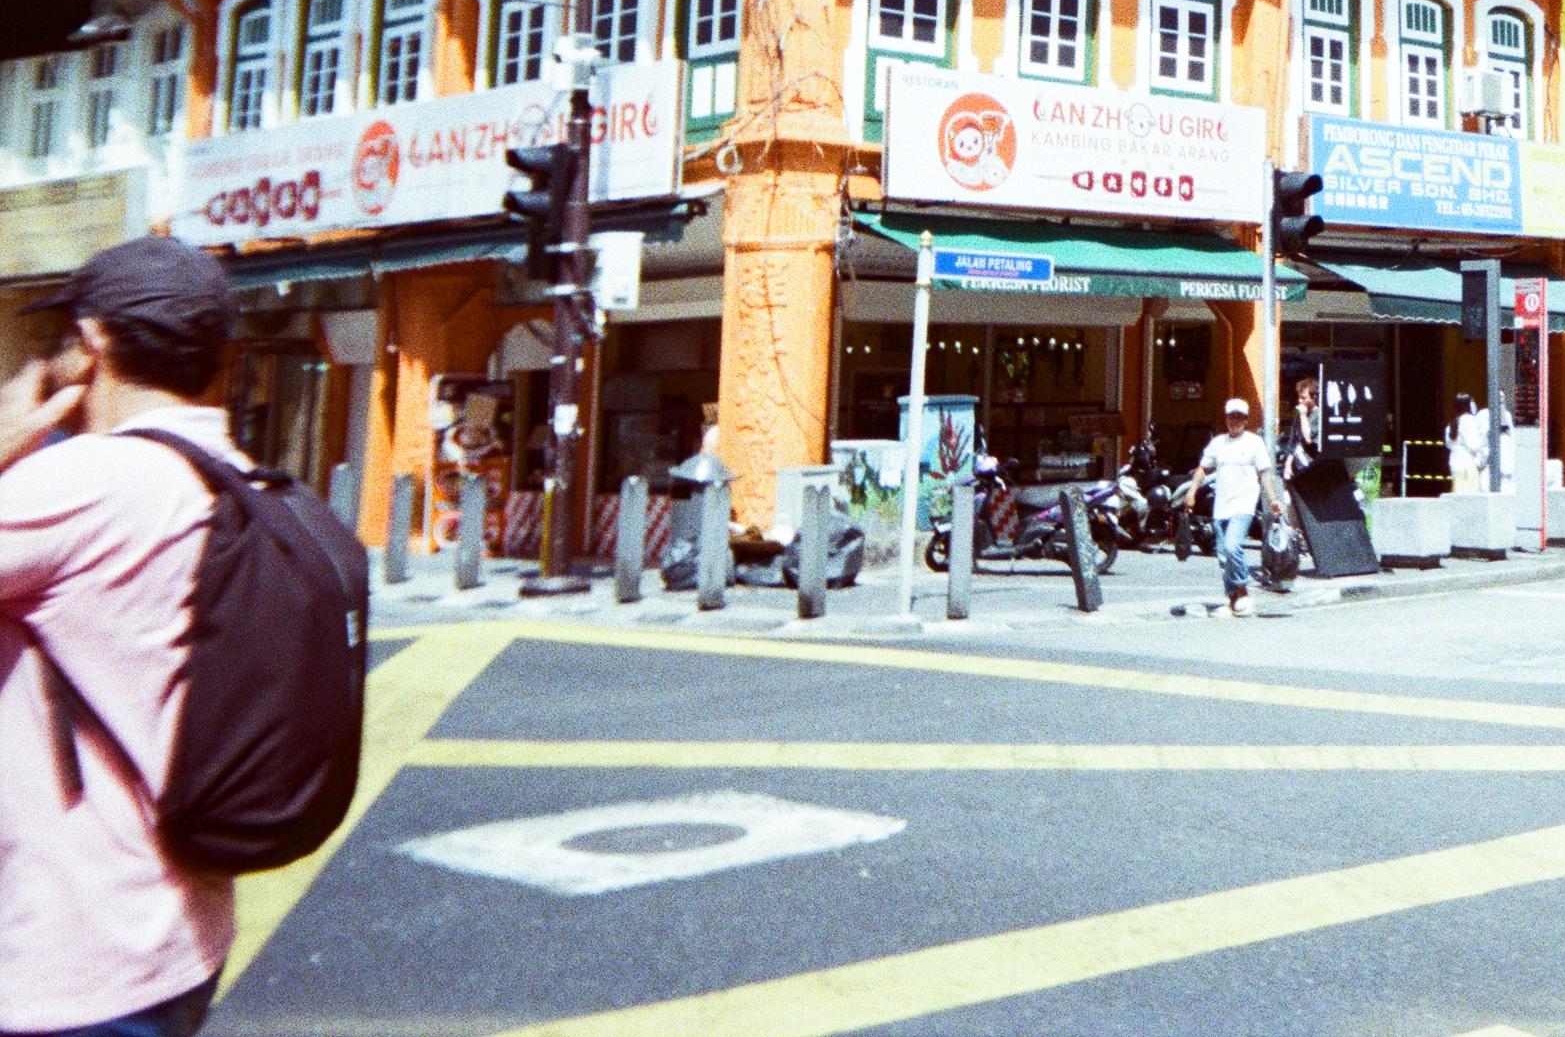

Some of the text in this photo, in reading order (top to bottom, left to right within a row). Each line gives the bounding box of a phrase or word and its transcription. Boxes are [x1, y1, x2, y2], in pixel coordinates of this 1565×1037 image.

[902, 74, 959, 90] RESTORAN
[1179, 115, 1229, 142] GIRL
[1323, 124, 1395, 146] PEMBORONG
[1396, 132, 1419, 150] DAN
[1422, 136, 1476, 155] PENGEDAR
[1478, 142, 1510, 159] PERAK
[1031, 131, 1231, 163] KAMBING BAKAR ARANG
[1323, 145, 1512, 189] ASCEND
[1323, 175, 1401, 194] SILVER
[1410, 181, 1458, 200] SDN.
[1468, 188, 1512, 204] BHD.
[954, 255, 987, 269] JALAN
[988, 257, 1034, 273] PETALING
[1180, 281, 1288, 301] PERKESA FLOST
